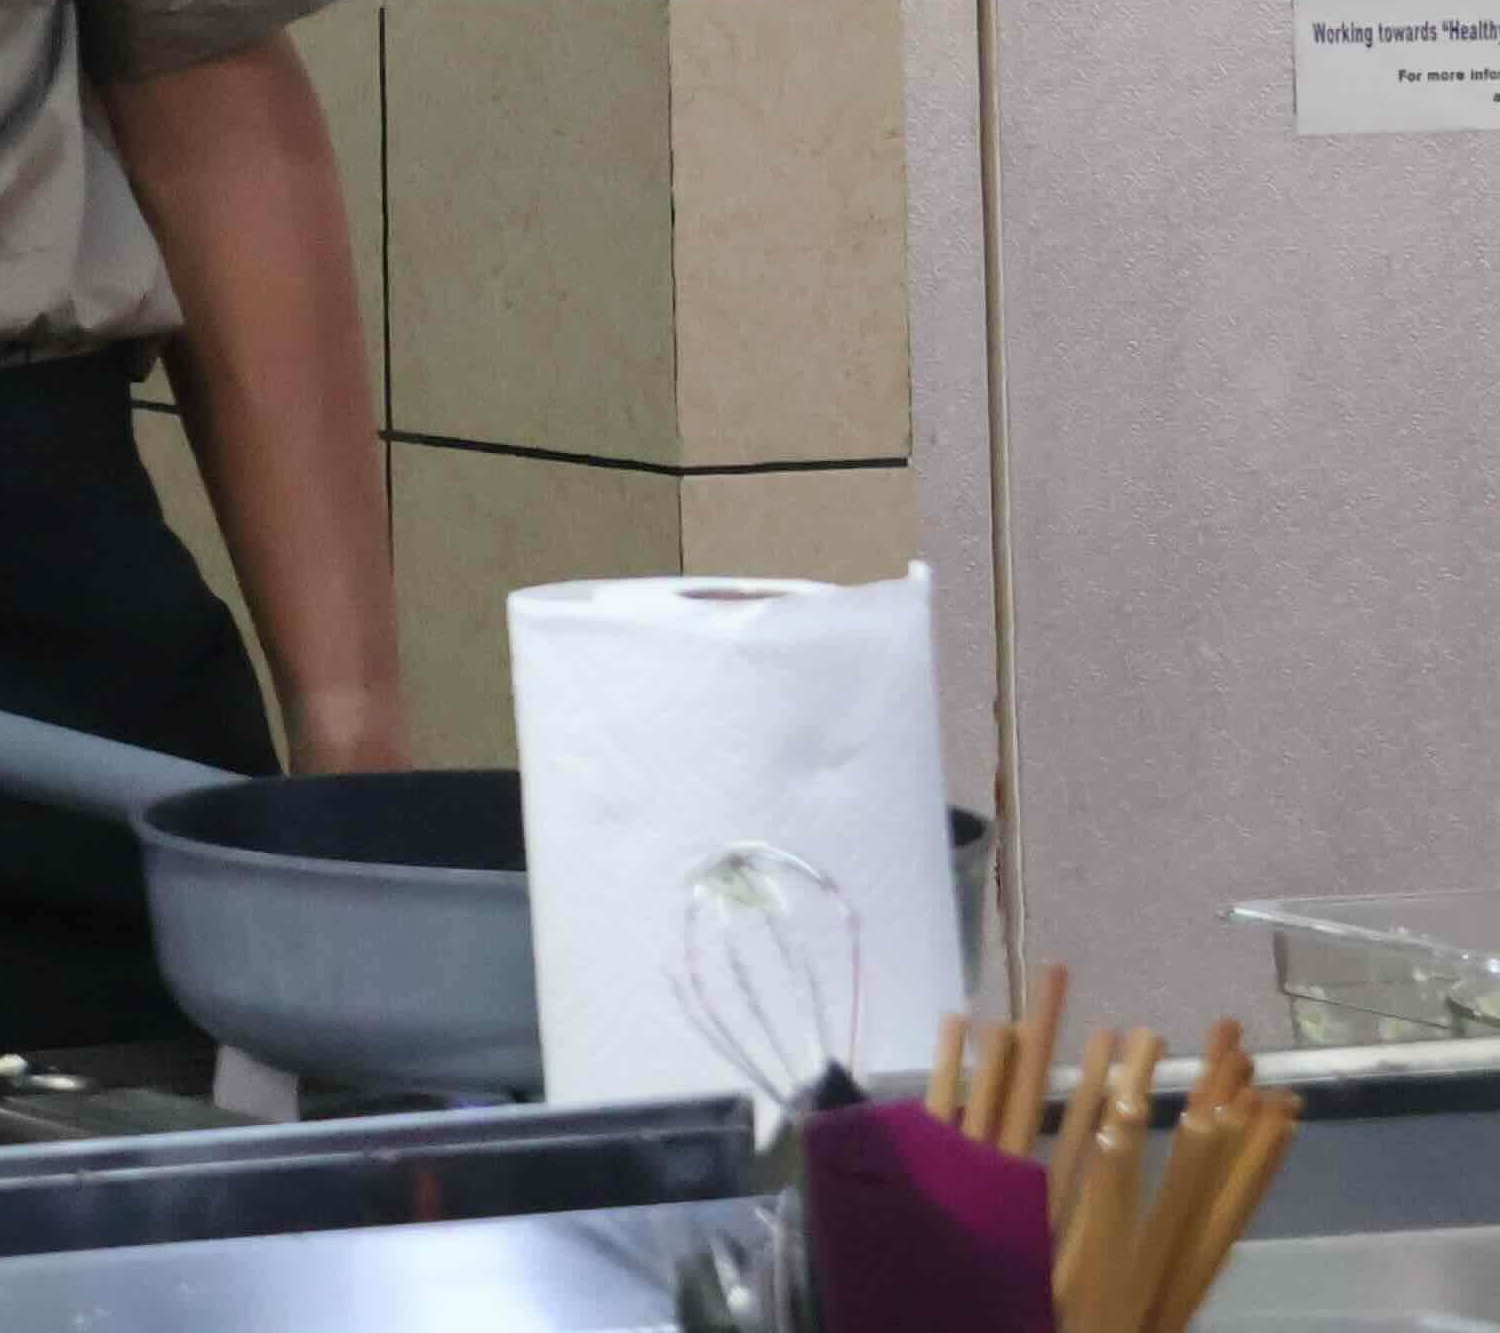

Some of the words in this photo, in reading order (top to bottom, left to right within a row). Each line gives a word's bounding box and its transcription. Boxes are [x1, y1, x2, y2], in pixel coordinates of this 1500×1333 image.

[1312, 21, 1374, 49] Working
[1378, 19, 1438, 43] towards
[1398, 69, 1422, 83] For
[1427, 71, 1466, 82] more
